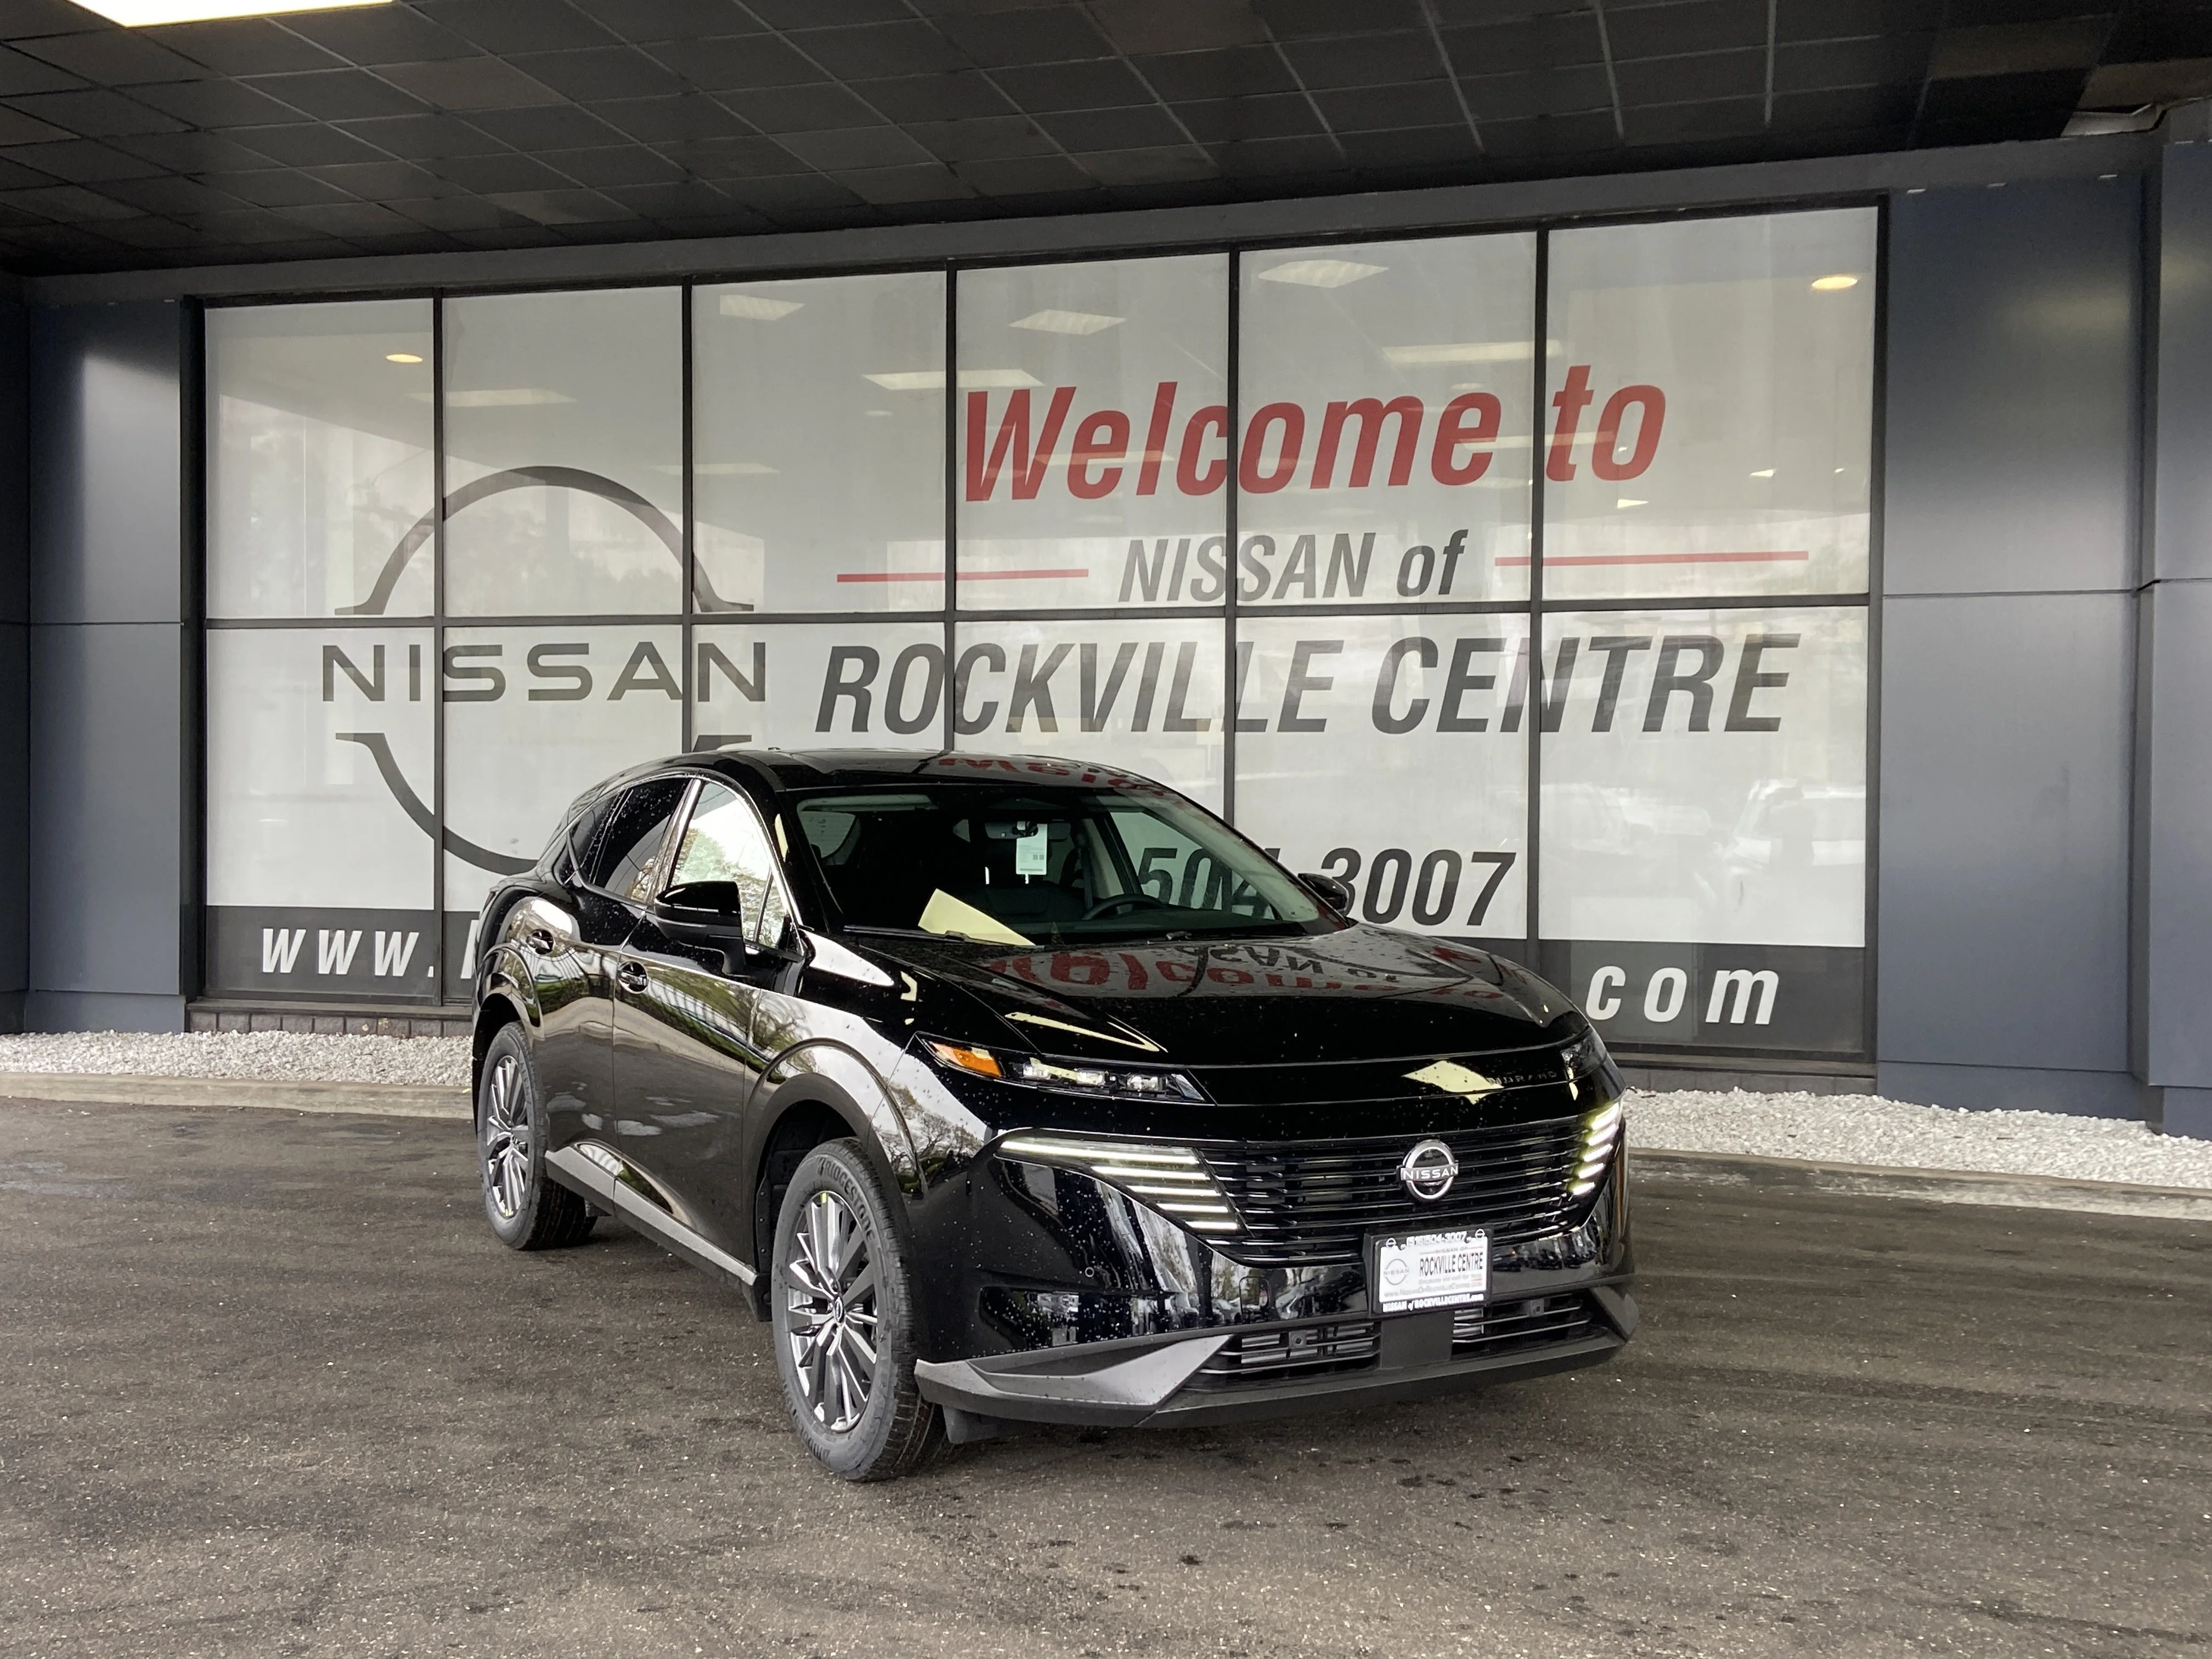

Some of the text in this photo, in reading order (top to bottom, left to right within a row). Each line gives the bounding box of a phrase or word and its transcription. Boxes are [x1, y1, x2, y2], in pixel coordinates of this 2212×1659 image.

[966, 365, 1666, 501] Welcome to
[1118, 529, 1469, 602] NISSAN of
[323, 641, 765, 702] NISSAN
[815, 633, 1801, 735] ROCKVILLE CENTRE
[817, 1157, 876, 1241] BRIDGESTONE
[1403, 1165, 1459, 1180] NISSAN
[1419, 1251, 1483, 1277] ROCKVILLE CENTRE
[1383, 1300, 1408, 1312] NISSAN
